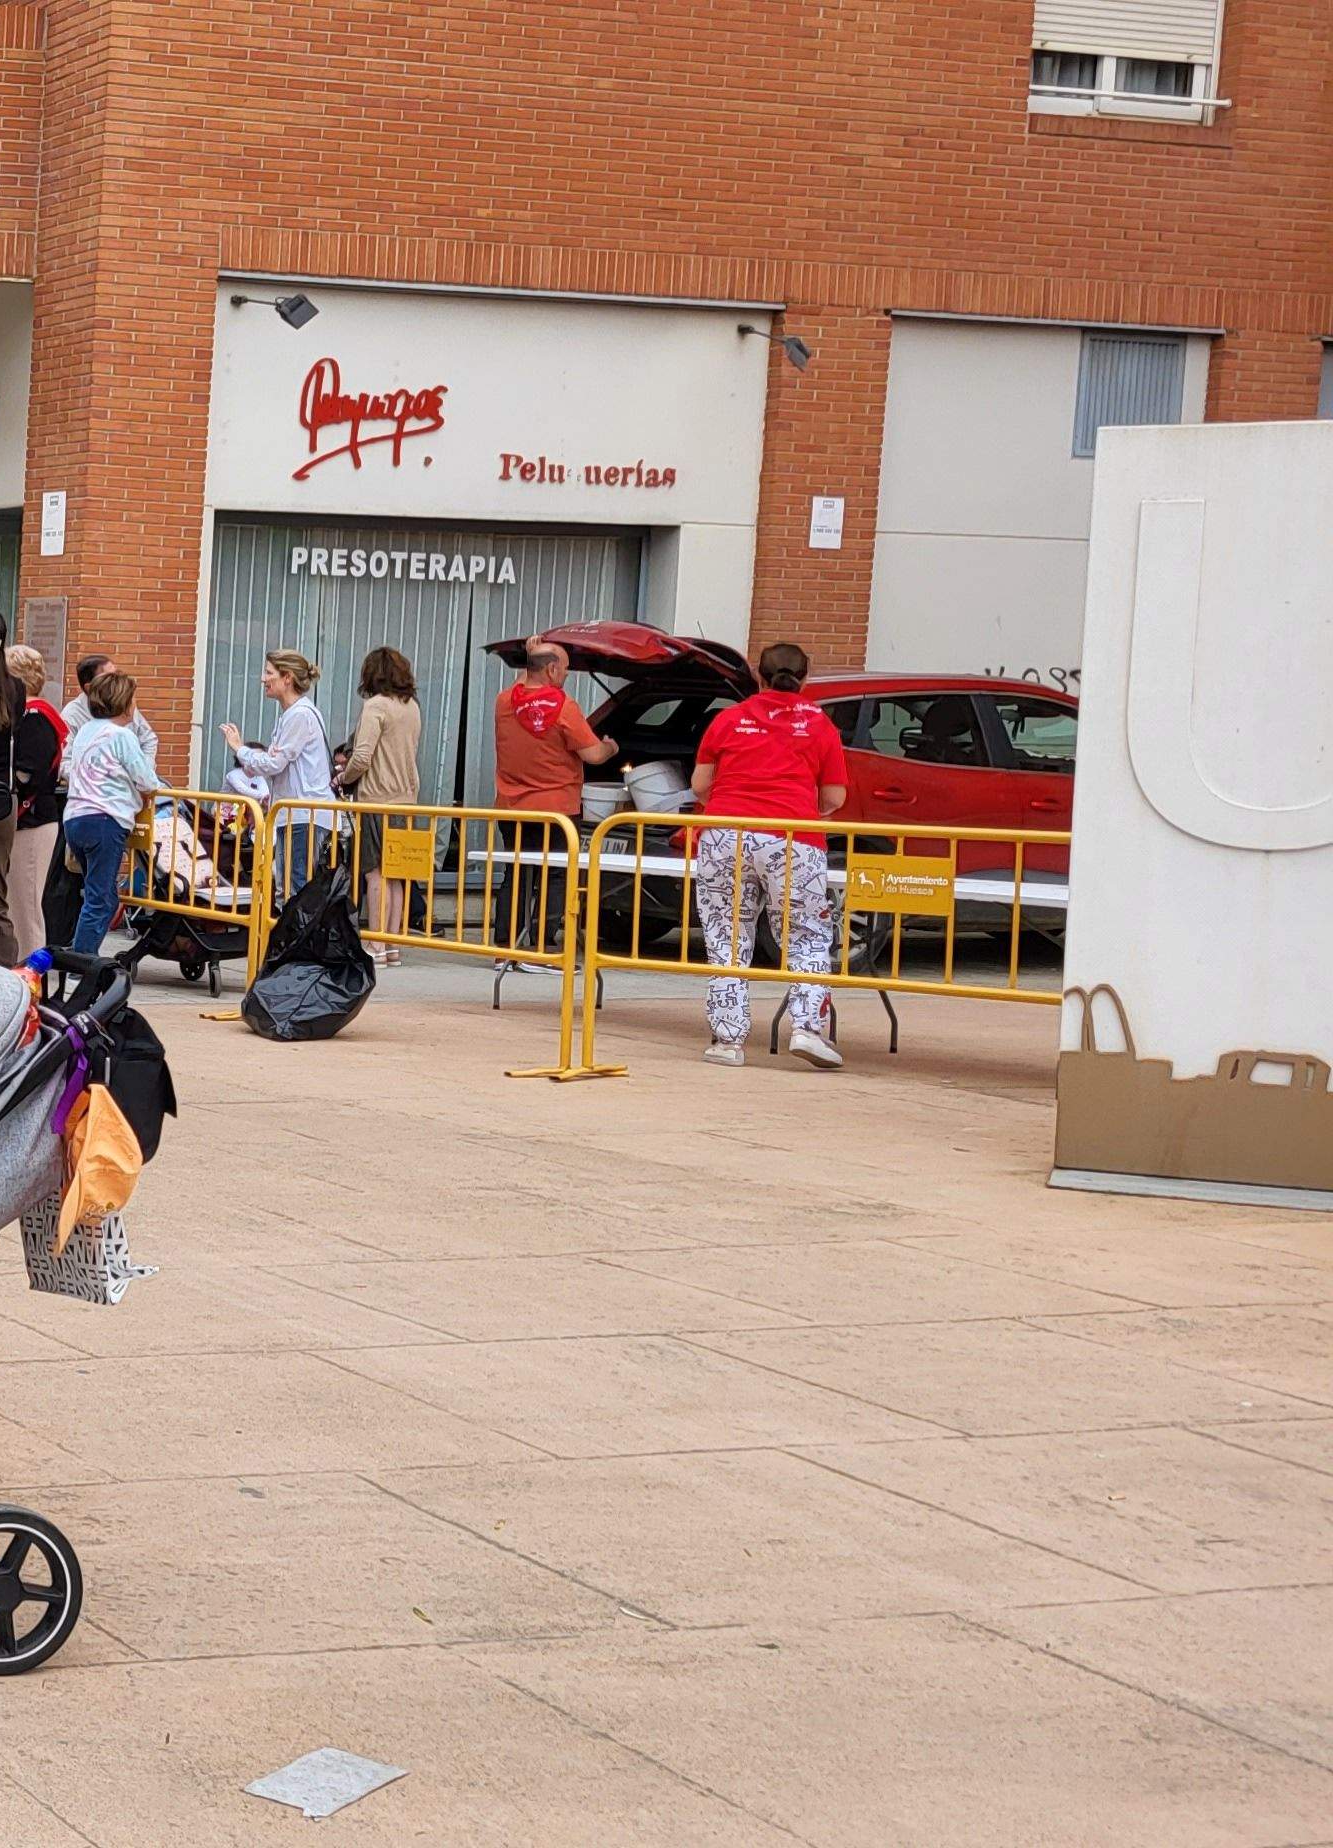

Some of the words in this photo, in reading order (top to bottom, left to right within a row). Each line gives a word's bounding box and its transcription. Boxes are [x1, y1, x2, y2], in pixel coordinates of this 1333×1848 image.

[498, 453, 677, 489] Peluuerías
[290, 546, 517, 585] PRESOTERAPIA
[886, 873, 949, 887] Ayuntamiento
[899, 885, 935, 896] Huesca
